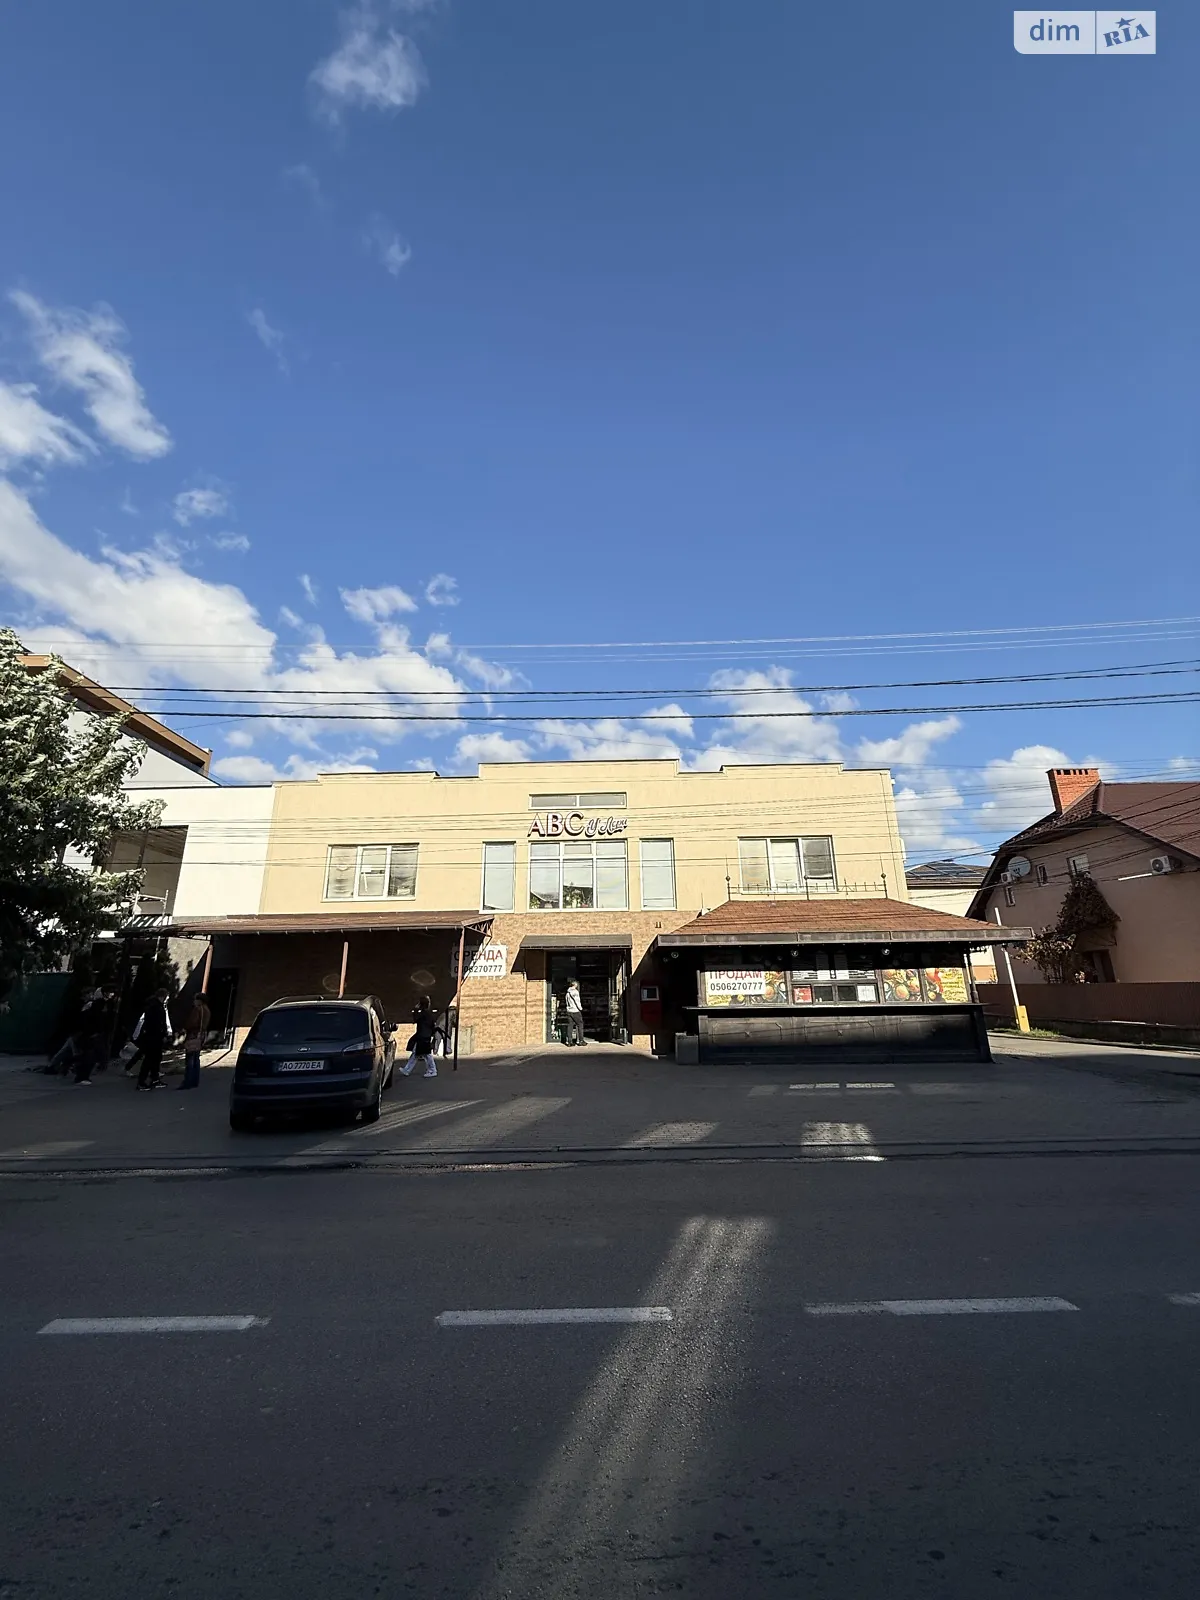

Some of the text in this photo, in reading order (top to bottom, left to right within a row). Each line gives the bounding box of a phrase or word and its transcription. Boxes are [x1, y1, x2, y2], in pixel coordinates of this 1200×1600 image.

[527, 811, 585, 837] ABC
[454, 965, 503, 974] 006270777
[709, 970, 763, 980] ПРОДАМ
[710, 982, 763, 991] 0506270777
